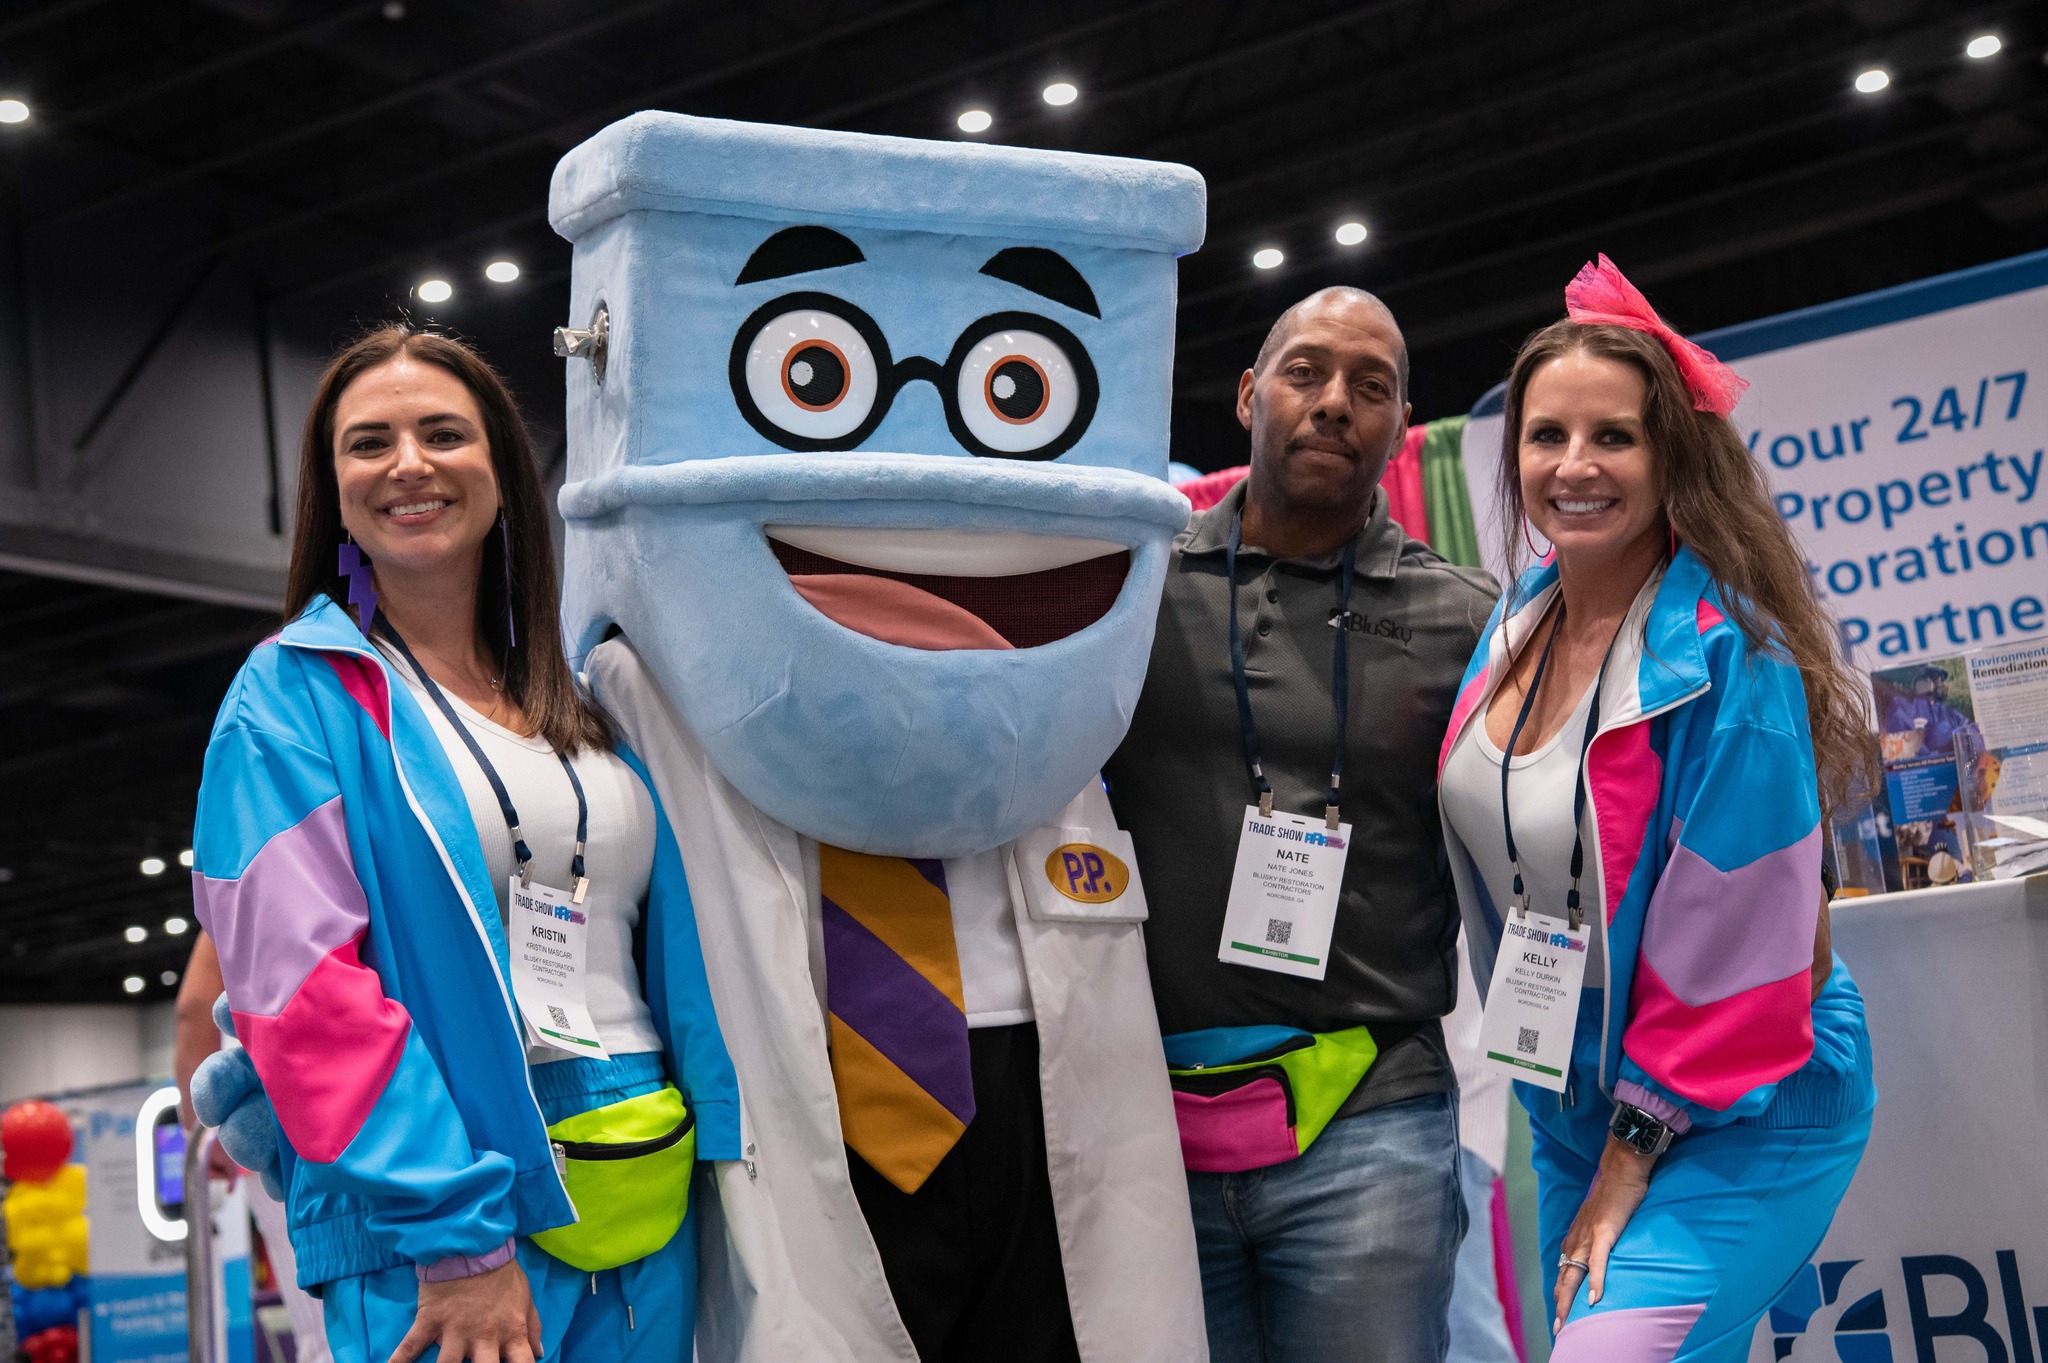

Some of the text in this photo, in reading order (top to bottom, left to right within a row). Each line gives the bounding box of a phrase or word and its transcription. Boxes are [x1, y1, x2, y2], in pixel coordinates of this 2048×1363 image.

[1891, 370, 2029, 444] 24/7
[1773, 450, 2044, 530] Property
[1805, 521, 2048, 597] toration
[1350, 612, 1412, 646] BluSky
[1839, 596, 2046, 663] Partne
[1970, 646, 2048, 669] Environmenta
[1972, 659, 2048, 679] Remediation
[1248, 821, 1276, 837] TRADE
[1277, 827, 1304, 842] SHOW
[1276, 849, 1310, 864] NATE
[1062, 852, 1112, 893] P.P.
[1266, 863, 1314, 878] NATE JONES
[1252, 871, 1325, 891] BLUSKY RESTORATION
[1262, 881, 1312, 896] CONTRACTORS
[515, 893, 533, 911] TRADE
[535, 901, 554, 917] SHOW
[531, 925, 566, 944] KRISTIN
[1507, 922, 1526, 938] TRADE
[1527, 927, 1550, 944] SHOW
[525, 942, 572, 960] KRISTIN MASCARI
[1522, 951, 1558, 969] KELLY
[523, 954, 575, 973] BLUSKY RESTORATION
[532, 964, 566, 978] CONTRACTORS
[1514, 967, 1561, 984] KELLY DURKIN
[1505, 977, 1567, 997] BLUSKY RESTORATION
[1514, 987, 1556, 1003] CONTRACTORS
